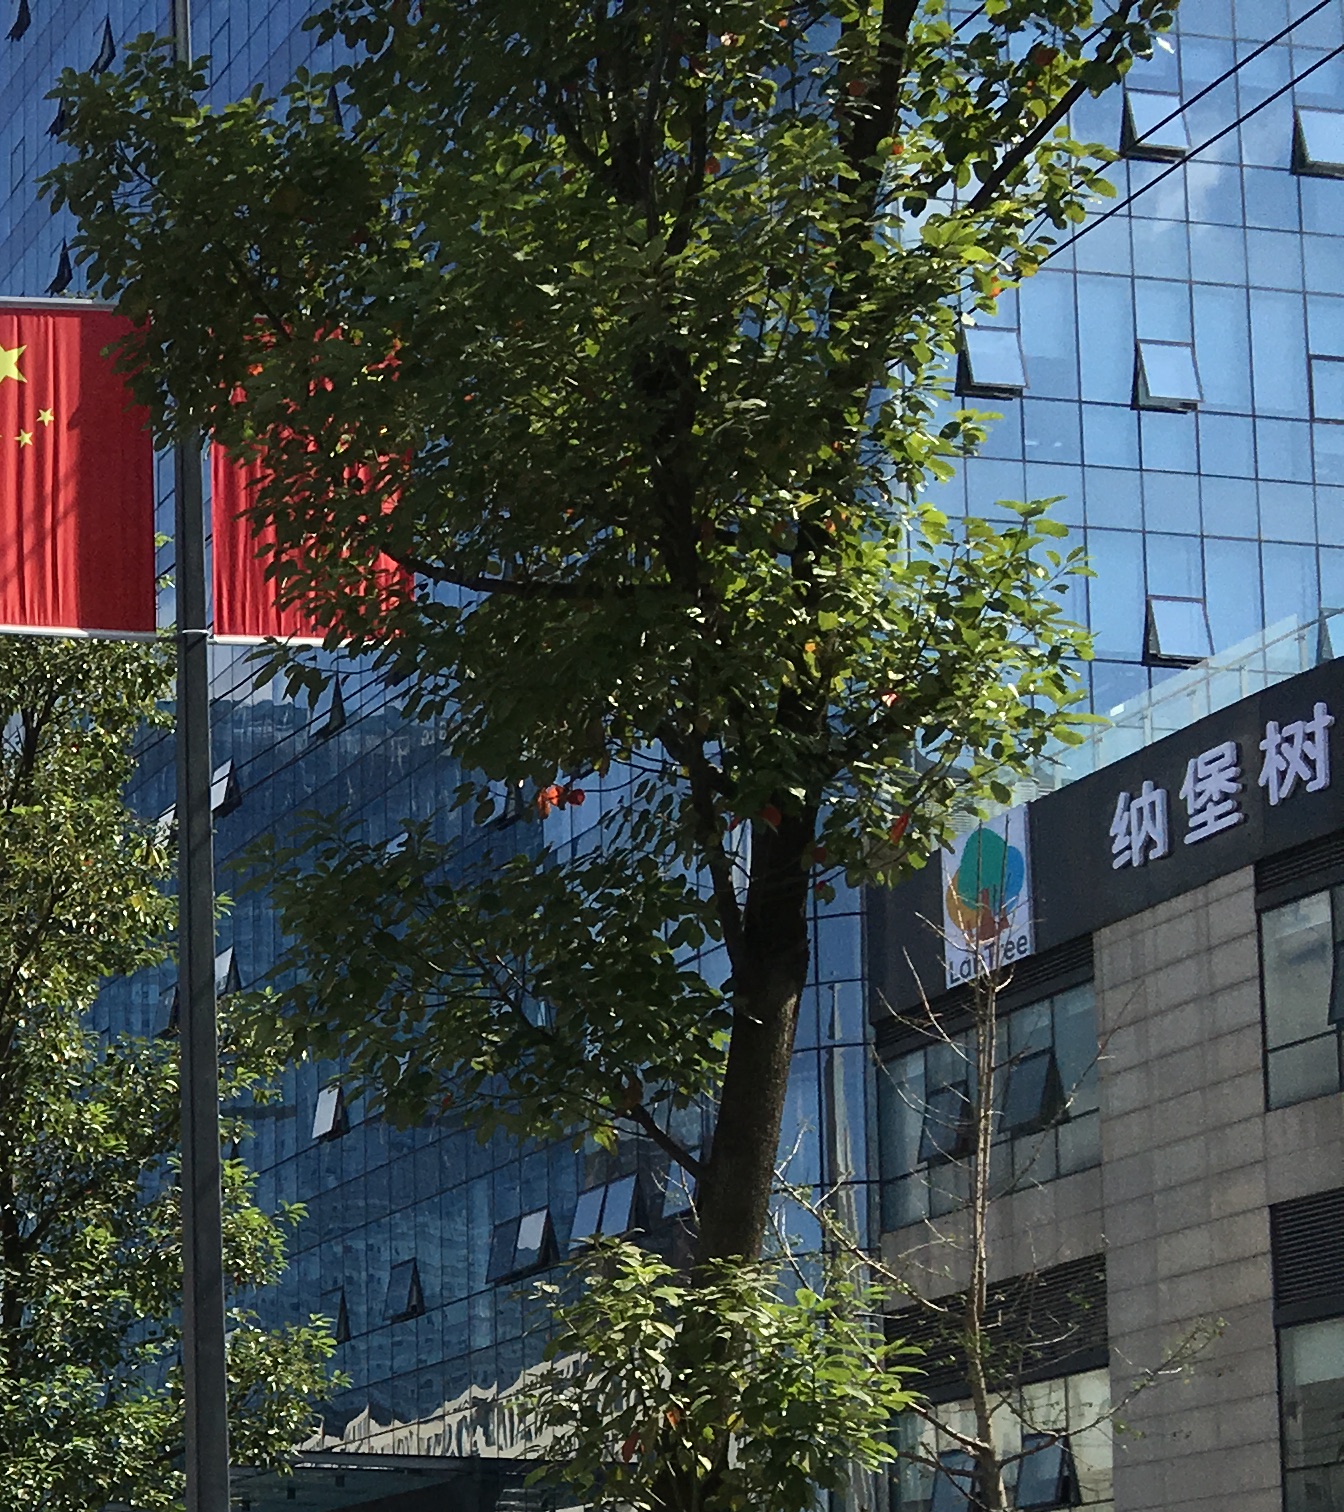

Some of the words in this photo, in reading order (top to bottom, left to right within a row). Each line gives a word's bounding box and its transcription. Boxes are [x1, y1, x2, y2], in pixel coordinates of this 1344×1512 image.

[1109, 702, 1335, 870] 纳堡树
[948, 934, 1028, 984] LaTee
